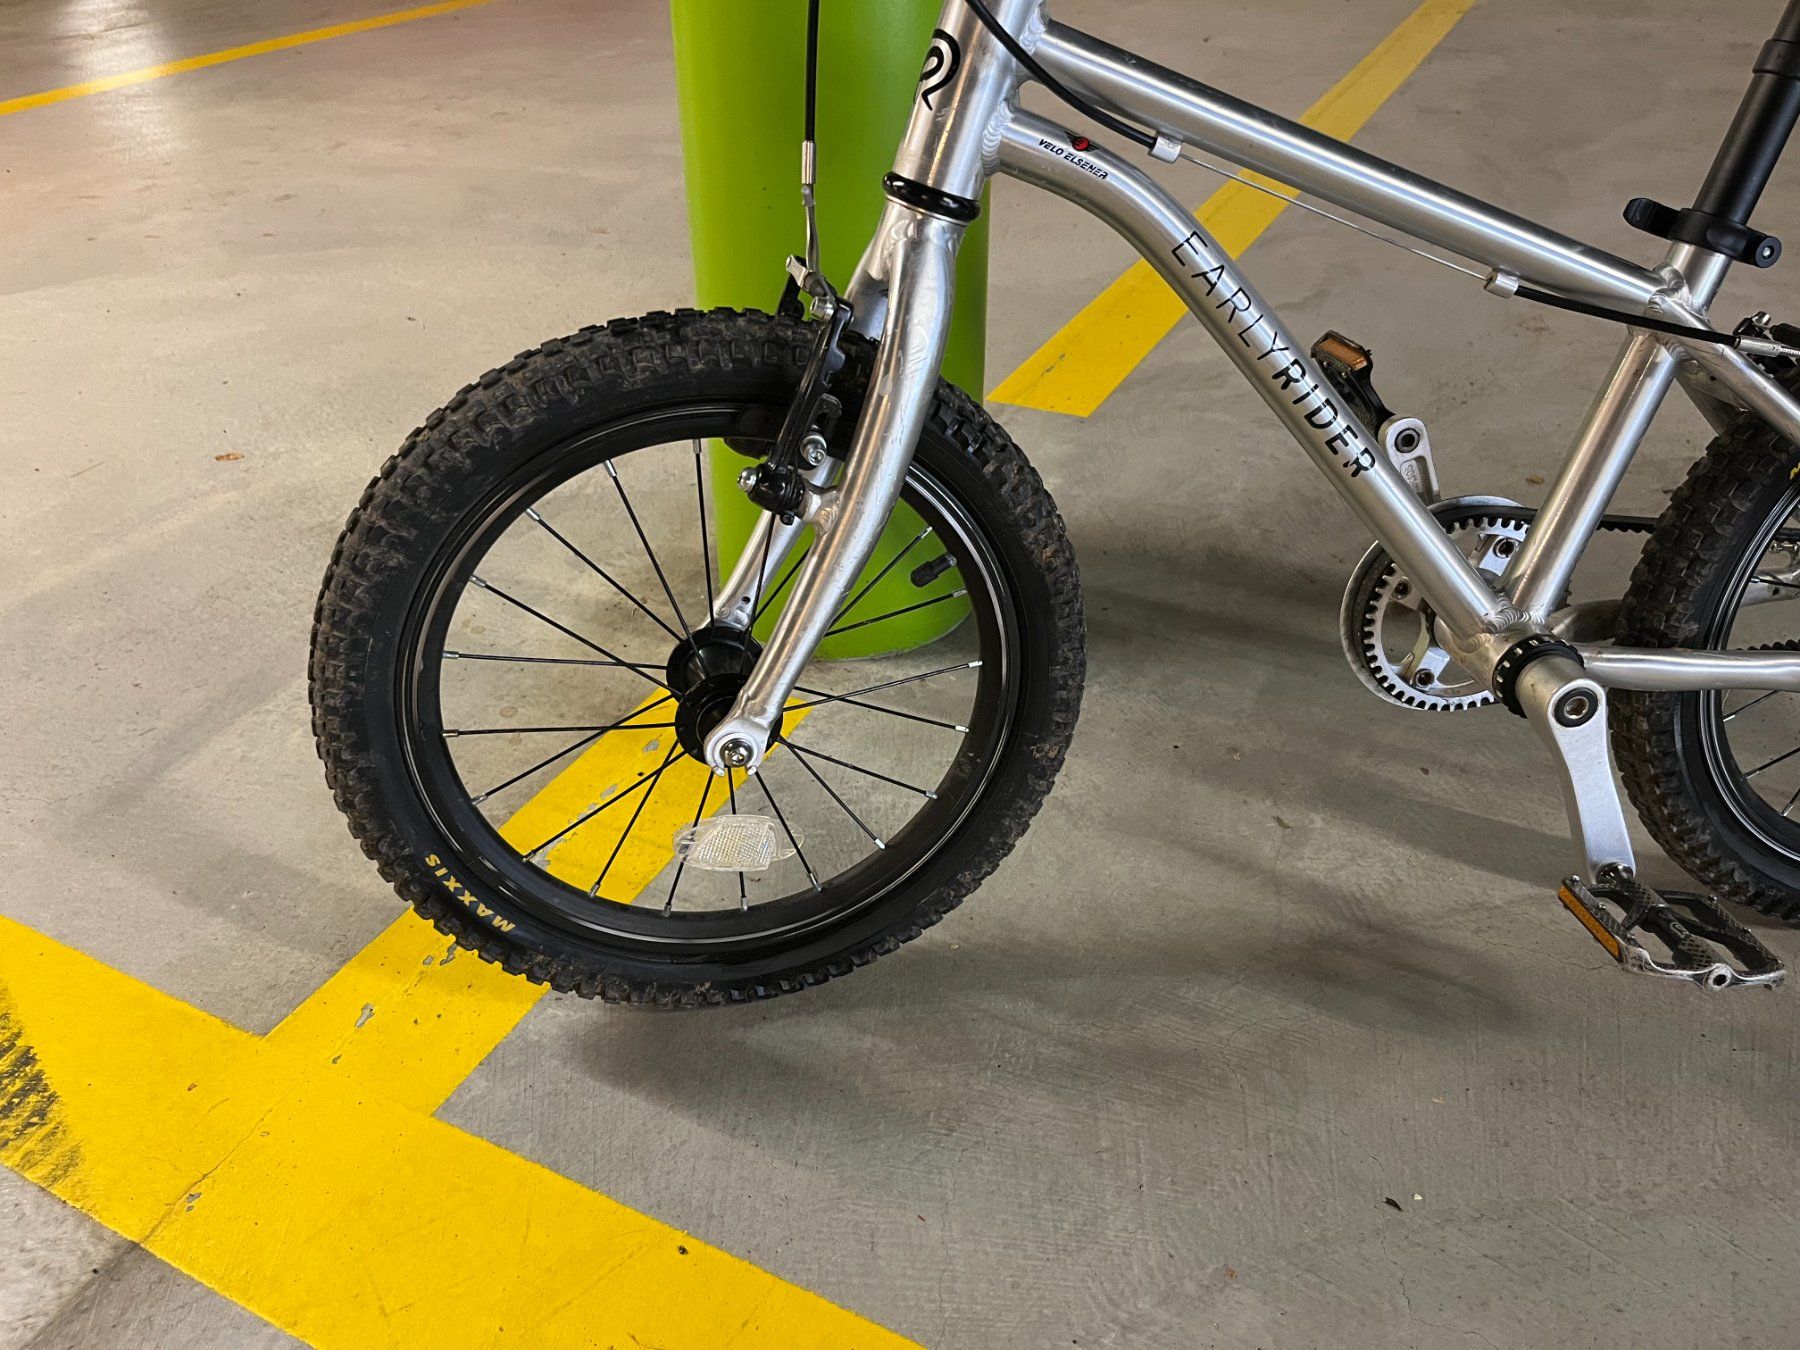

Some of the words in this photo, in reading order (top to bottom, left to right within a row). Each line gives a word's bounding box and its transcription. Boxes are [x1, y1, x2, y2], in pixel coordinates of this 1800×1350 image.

[1039, 139, 1064, 156] VELO
[1063, 153, 1109, 180] ELSENER
[425, 854, 516, 932] MAXXIS
